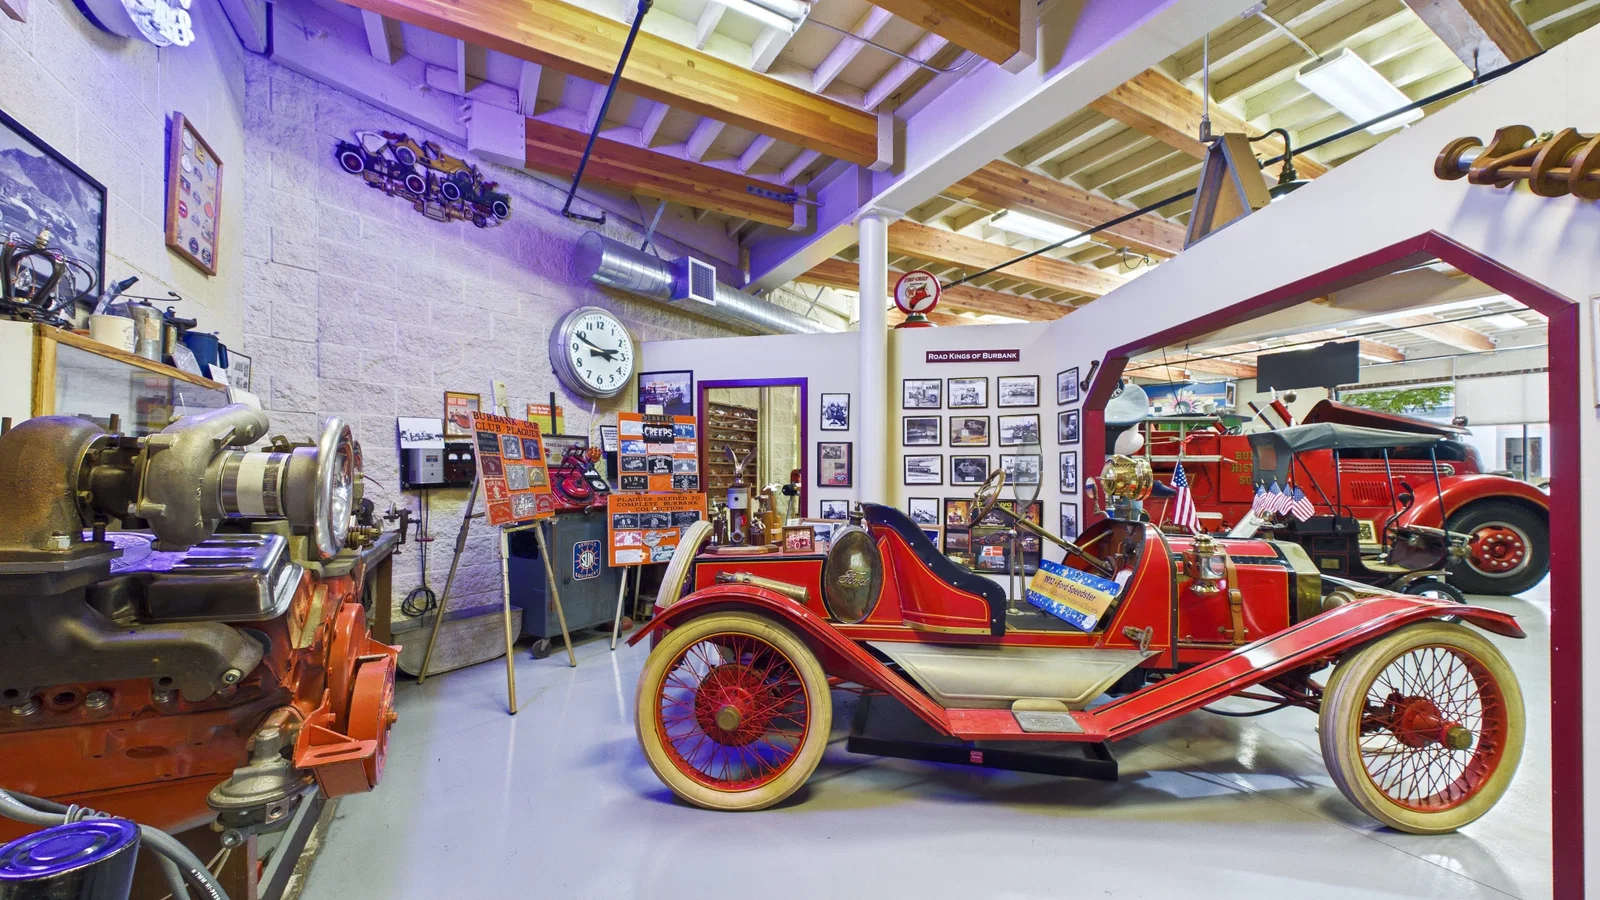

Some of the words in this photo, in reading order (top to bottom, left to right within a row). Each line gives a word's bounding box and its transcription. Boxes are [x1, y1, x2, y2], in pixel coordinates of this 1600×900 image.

[586, 322, 593, 331] 11
[596, 321, 604, 330] 12
[572, 343, 579, 352] 9
[618, 340, 623, 348] 2
[620, 353, 626, 362] 3
[576, 358, 583, 367] 8
[586, 370, 592, 379] 7
[616, 366, 622, 375] 4
[597, 375, 603, 384] 6
[609, 374, 614, 383] 5
[472, 411, 517, 426] BURBANK
[524, 421, 539, 429] CAR
[475, 422, 501, 432] CLUB
[506, 426, 540, 437] PLAQUES
[644, 426, 672, 438] CREEPS
[581, 552, 594, 568] SUN
[838, 570, 869, 586] Ford
[1043, 575, 1056, 585] 1912
[1056, 580, 1070, 591] Ford
[1068, 583, 1096, 602] Speedster
